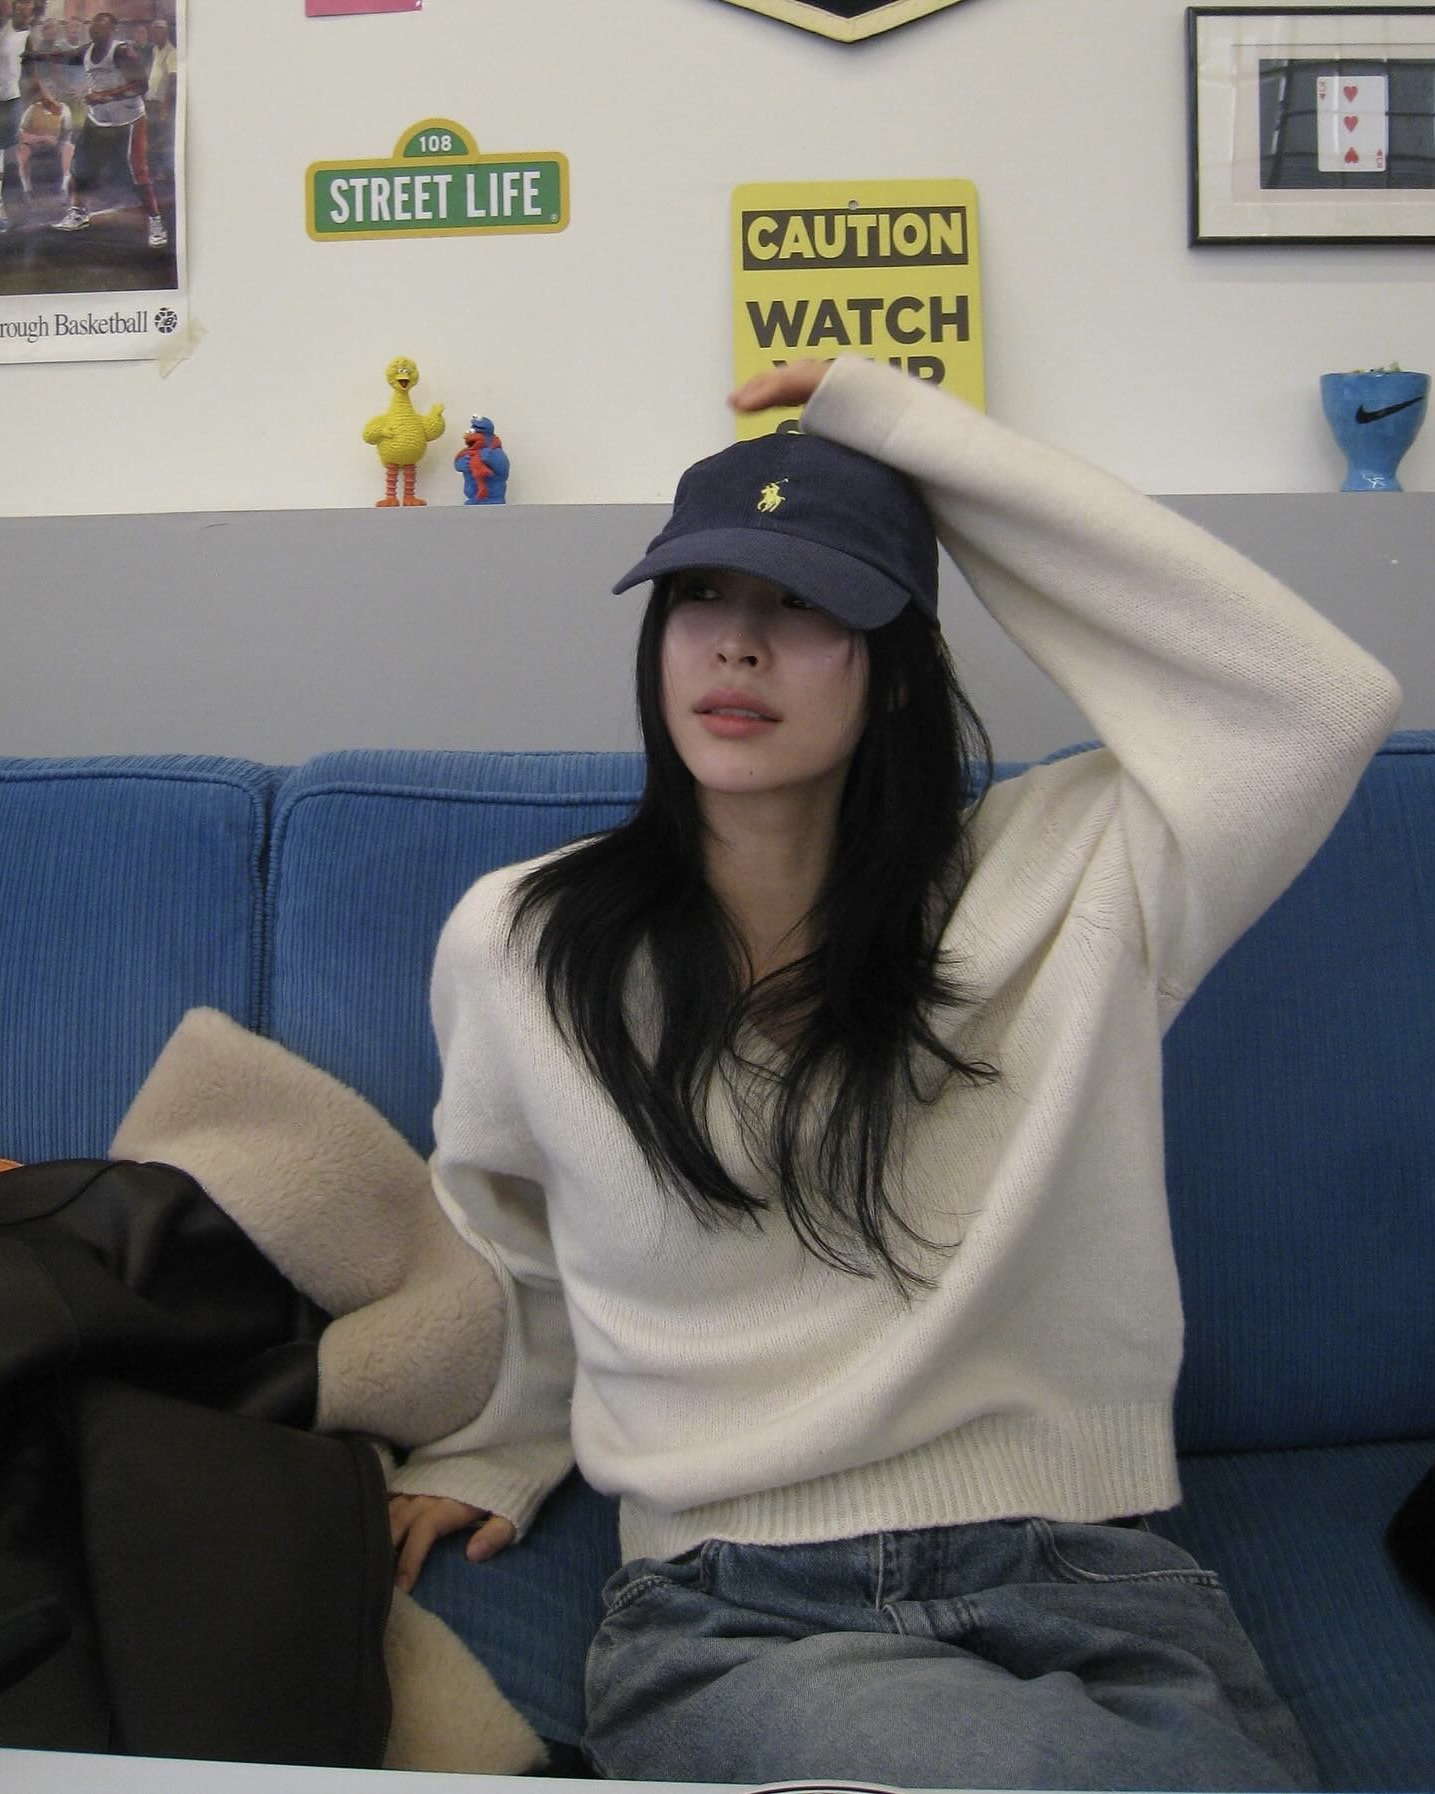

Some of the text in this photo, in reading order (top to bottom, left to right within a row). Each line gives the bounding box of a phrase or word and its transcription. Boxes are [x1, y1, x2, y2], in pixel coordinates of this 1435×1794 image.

[419, 135, 452, 152] 108
[330, 171, 542, 224] STREET LIFE
[747, 212, 964, 260] CAUTION
[54, 310, 148, 337] Basketball
[746, 295, 970, 348] WATCH
